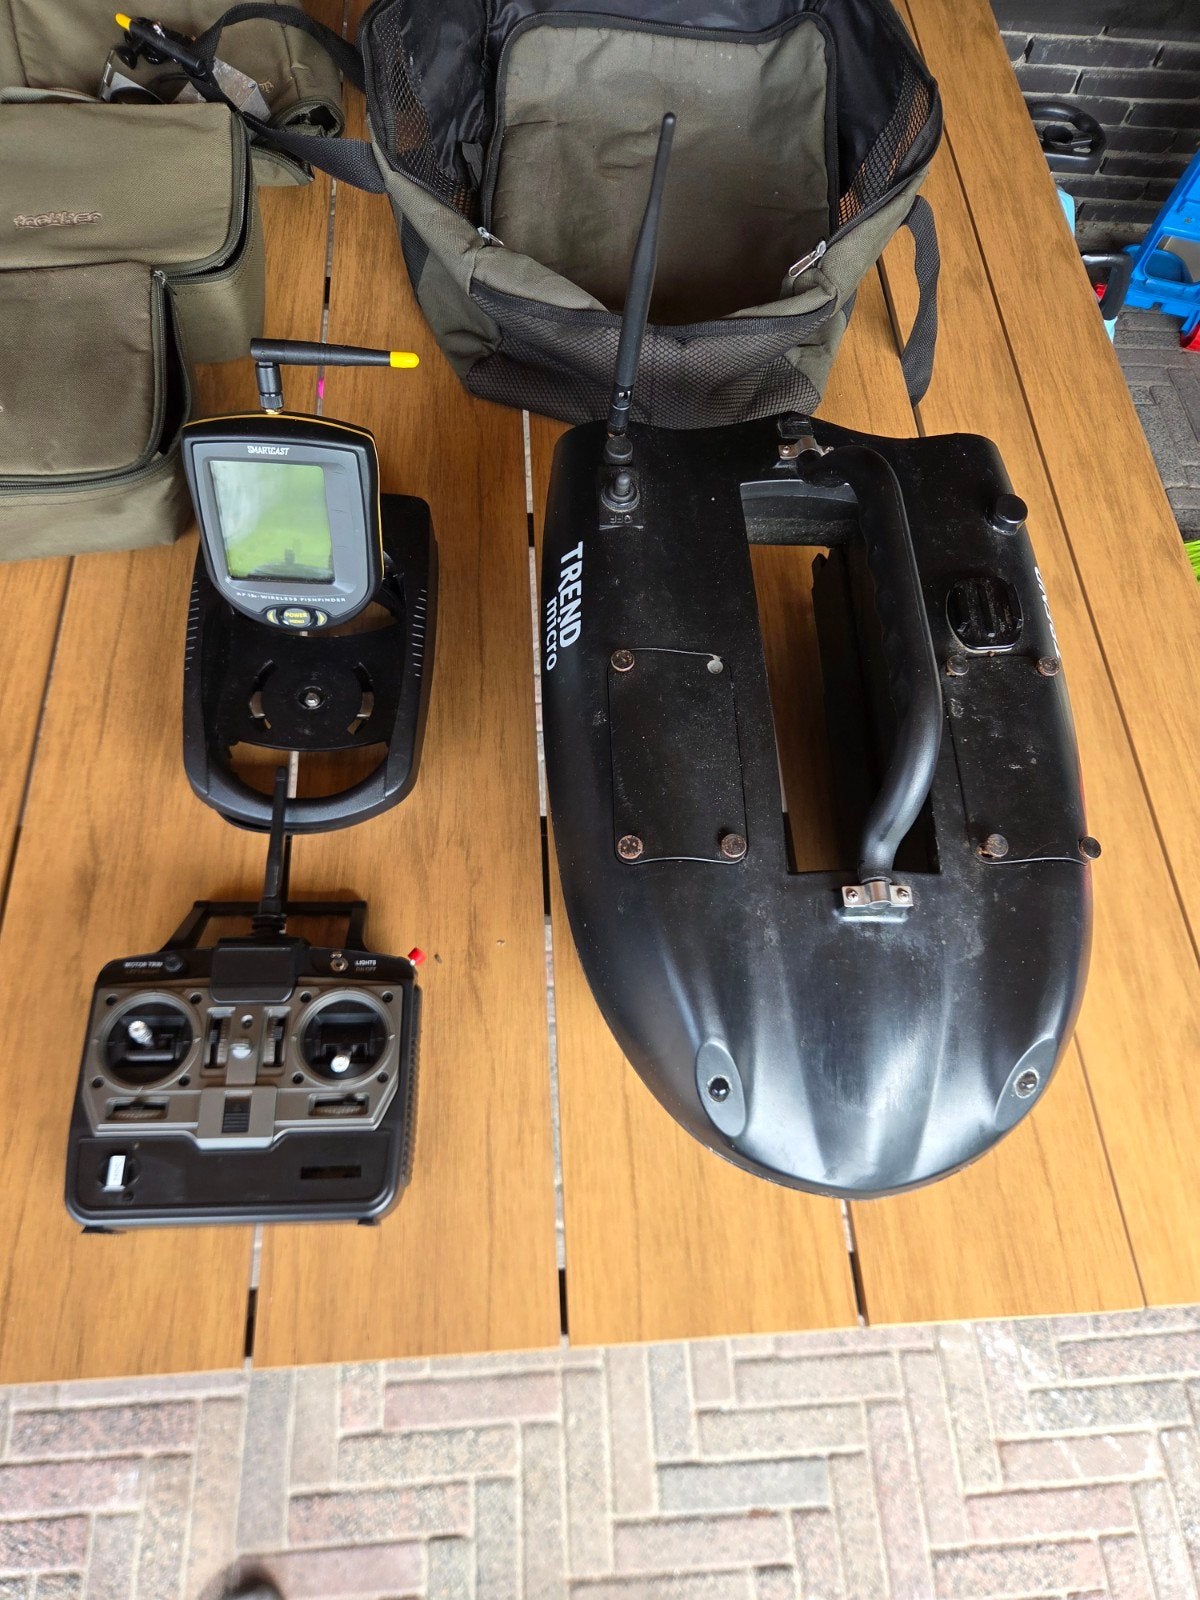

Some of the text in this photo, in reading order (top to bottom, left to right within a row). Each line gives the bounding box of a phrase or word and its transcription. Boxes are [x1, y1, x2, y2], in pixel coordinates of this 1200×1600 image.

[247, 445, 290, 456] SMARTCAST
[260, 594, 298, 602] WIRELESS
[558, 540, 584, 648] TREND
[546, 596, 562, 671] micro
[354, 959, 377, 967] LIGHTS
